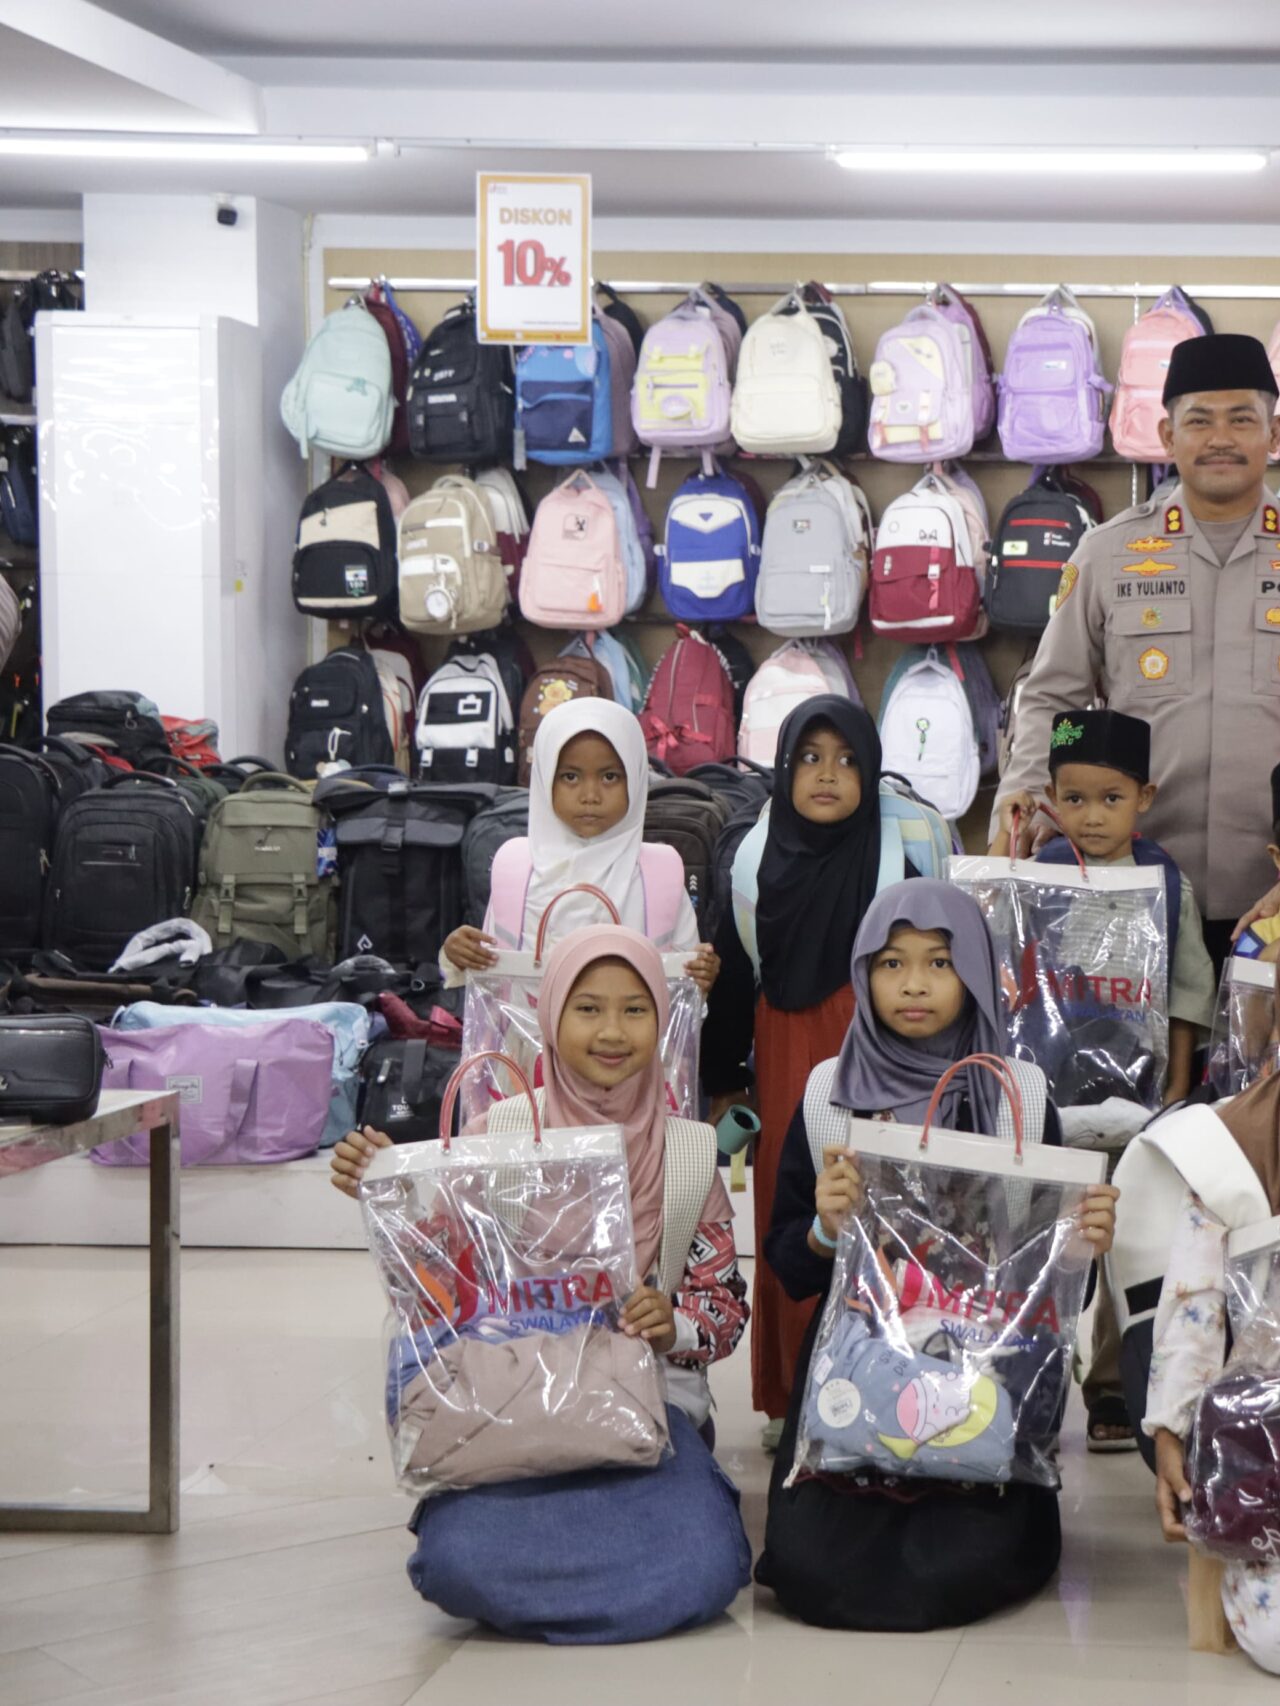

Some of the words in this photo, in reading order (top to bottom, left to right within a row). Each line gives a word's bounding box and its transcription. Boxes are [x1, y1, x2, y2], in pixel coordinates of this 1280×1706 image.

[499, 207, 573, 226] DISKON
[497, 239, 572, 287] 10%
[1116, 582, 1132, 597] IKE
[1137, 580, 1186, 596] YULIANTO
[487, 1271, 614, 1314] MITRA
[926, 1280, 1061, 1334] MITRA
